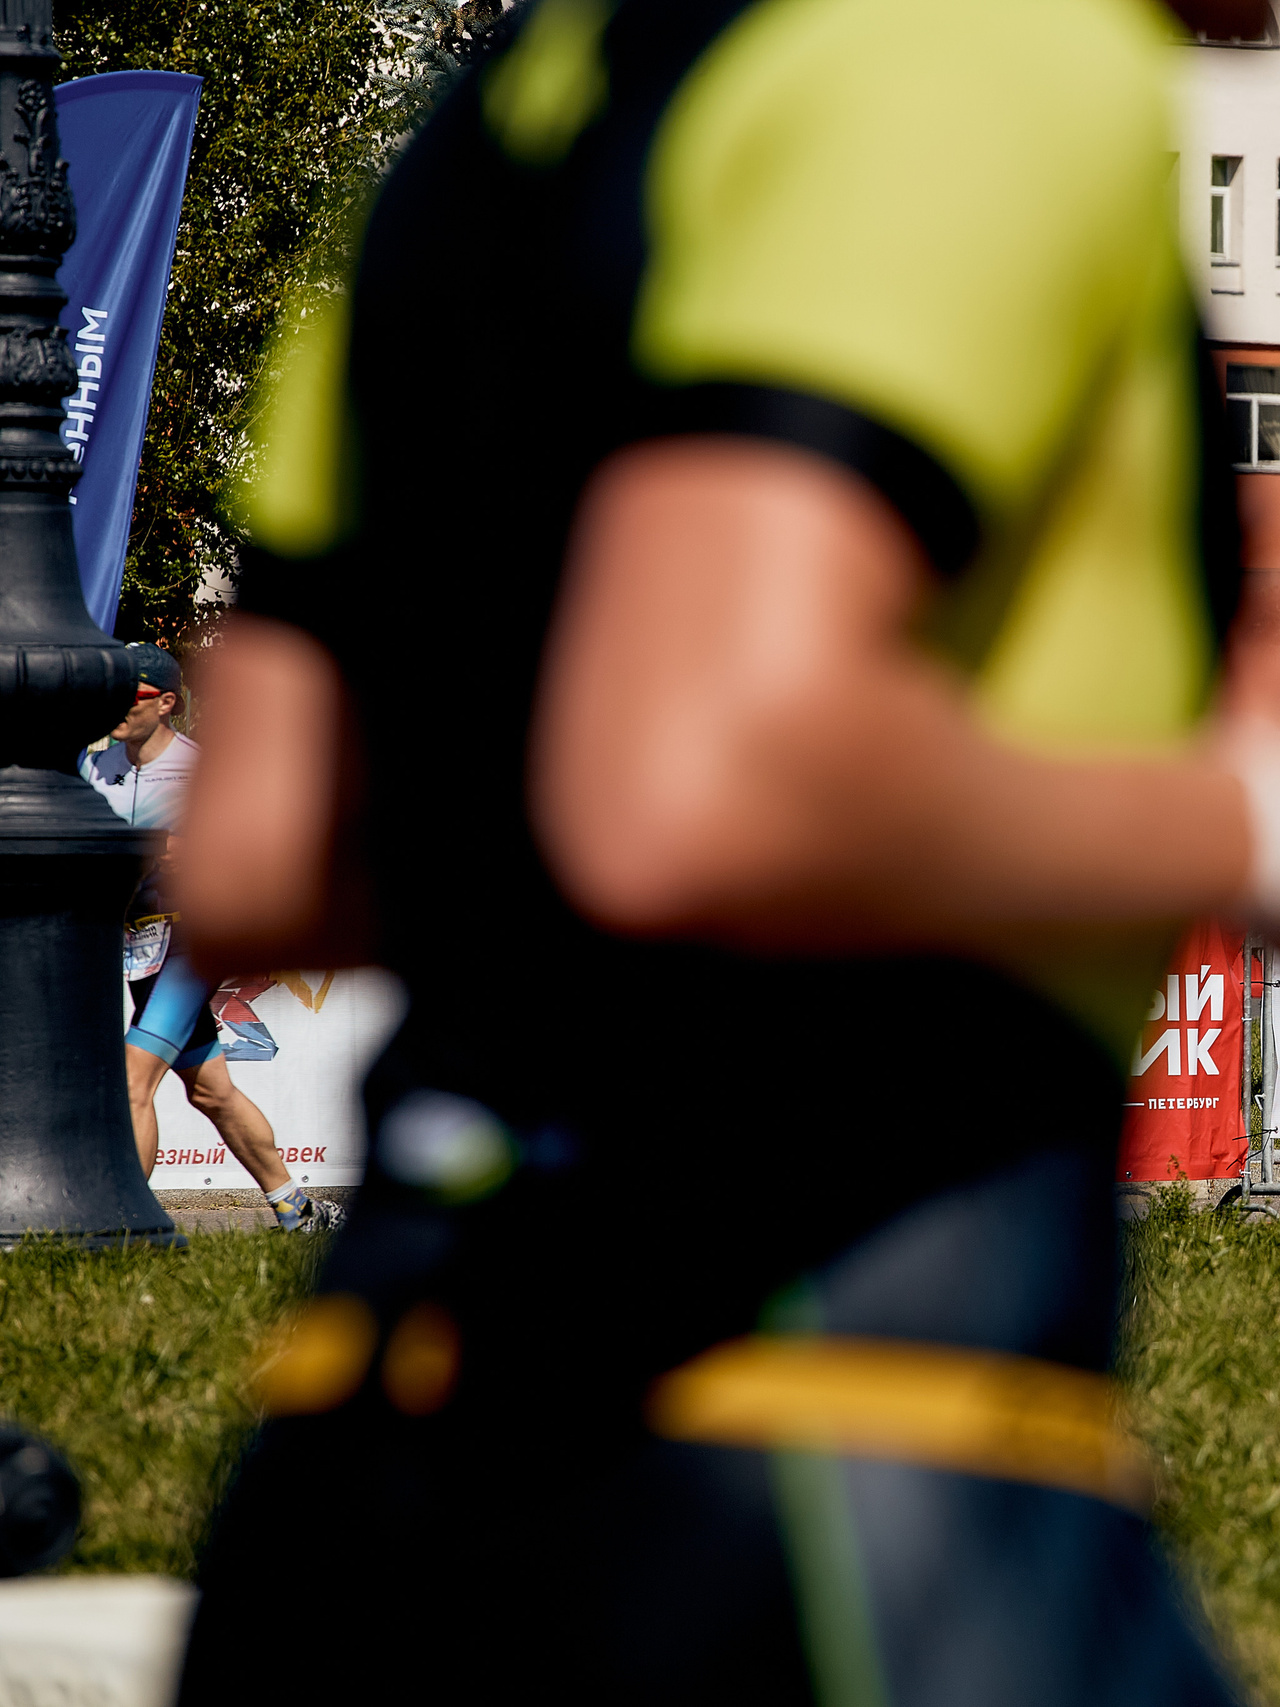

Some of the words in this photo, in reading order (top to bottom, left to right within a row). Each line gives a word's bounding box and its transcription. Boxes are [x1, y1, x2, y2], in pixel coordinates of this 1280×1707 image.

[1145, 965, 1225, 1022] ЫЙ
[1131, 1028, 1223, 1077] ИК
[1148, 1097, 1220, 1110] ПЕТЕРБУРГ
[155, 1141, 226, 1165] езный
